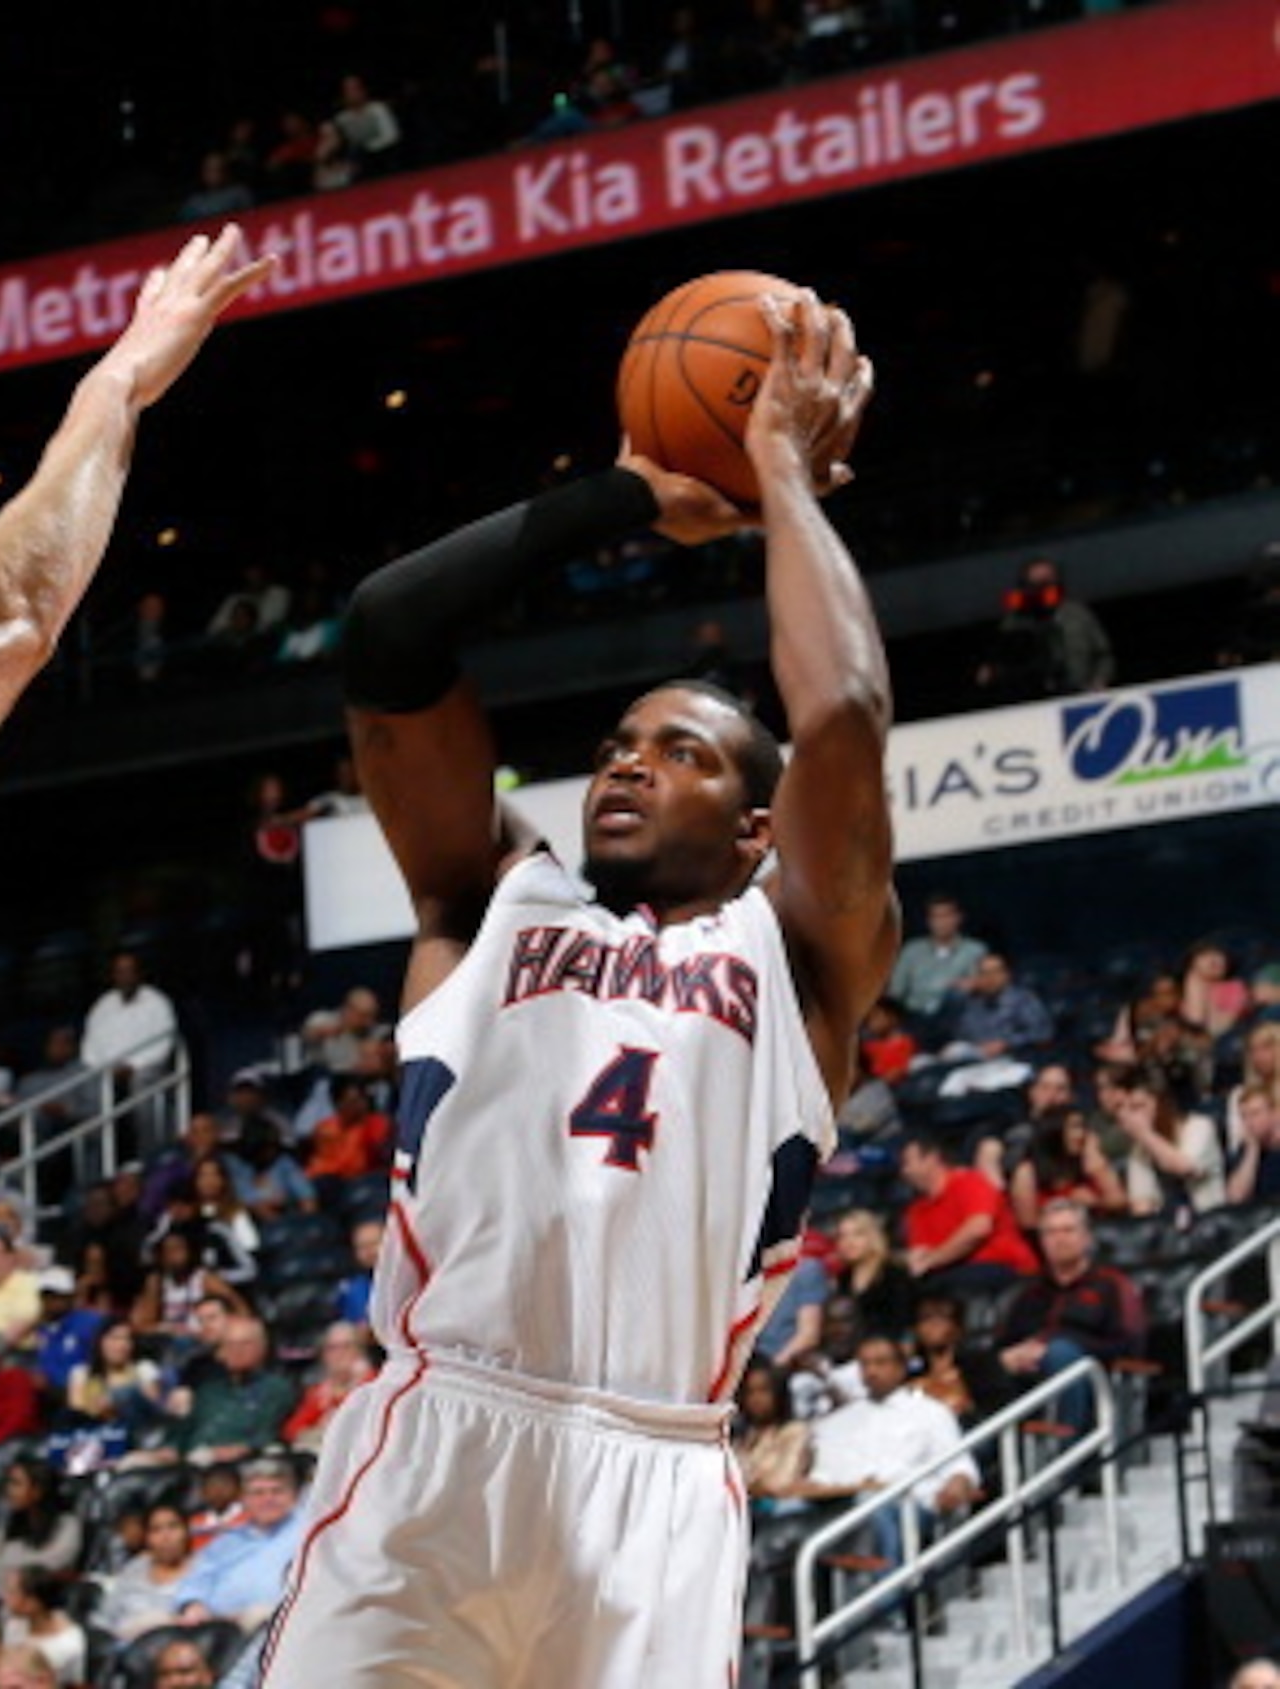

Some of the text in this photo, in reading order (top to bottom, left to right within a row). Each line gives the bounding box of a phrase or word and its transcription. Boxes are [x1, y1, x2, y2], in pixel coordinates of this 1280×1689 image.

[513, 152, 642, 244] Kia
[663, 73, 1046, 208] Retailers
[884, 742, 1043, 811] IA'S
[983, 778, 1251, 836] CREDIT UNION
[500, 925, 760, 1048] HAWKS
[568, 1043, 662, 1172] 4
